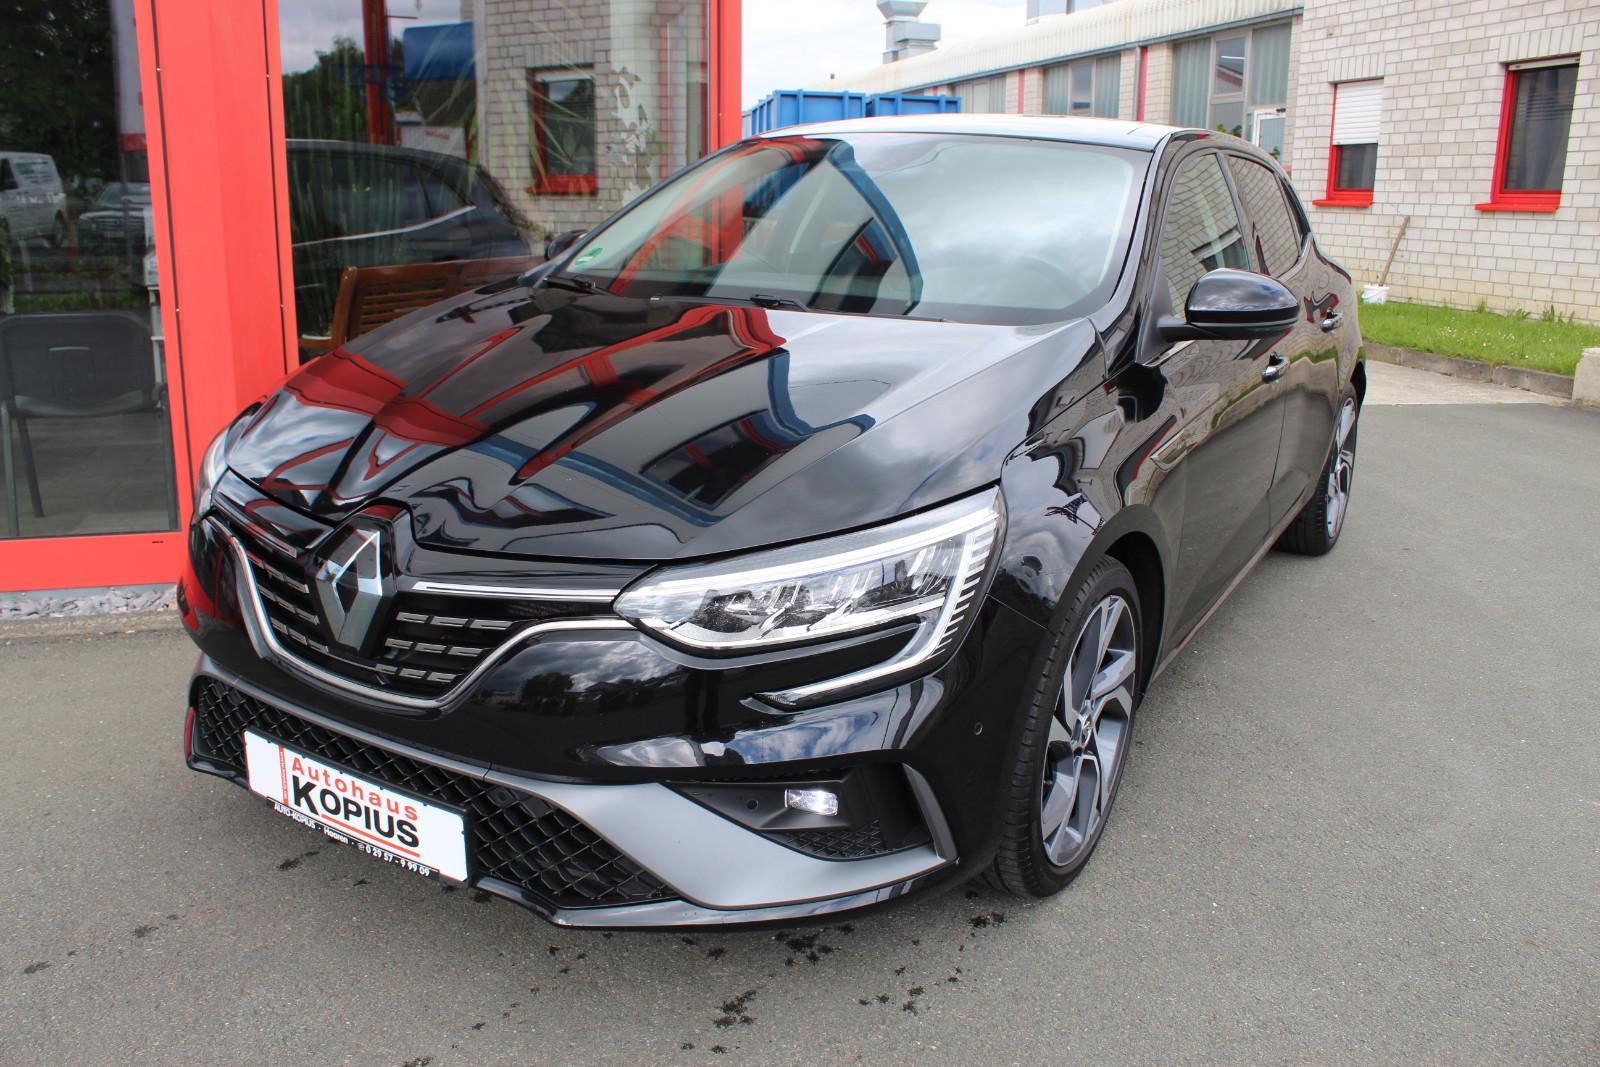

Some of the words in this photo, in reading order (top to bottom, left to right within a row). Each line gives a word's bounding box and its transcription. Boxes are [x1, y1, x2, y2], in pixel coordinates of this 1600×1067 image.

[292, 757, 418, 820] Autohaus
[292, 775, 419, 847] KOPIUS
[323, 826, 349, 845] Haaren
